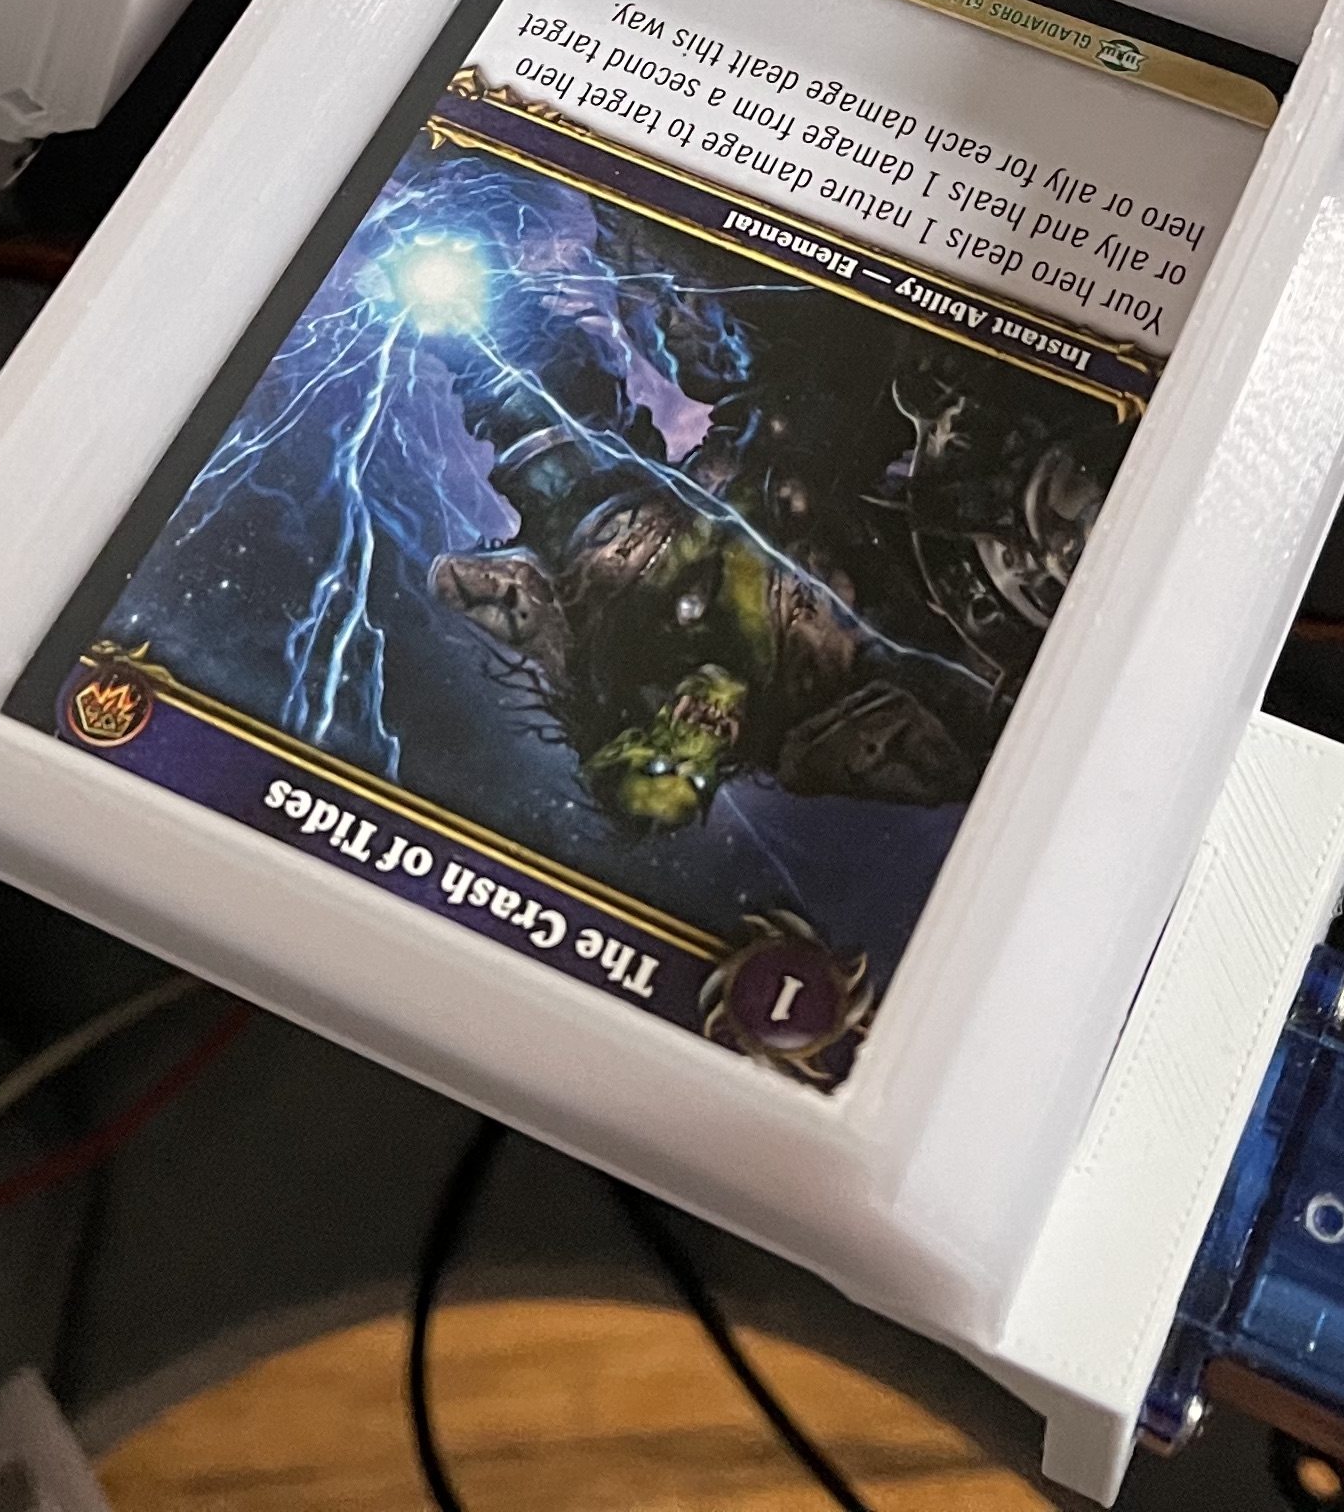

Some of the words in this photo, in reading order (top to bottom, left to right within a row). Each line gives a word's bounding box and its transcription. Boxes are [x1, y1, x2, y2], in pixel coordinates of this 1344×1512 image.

[517, 12, 601, 64] target
[611, 2, 665, 40] way.
[989, 2, 1093, 50] GLADIATORS
[671, 28, 725, 67] this
[515, 57, 575, 100] hero
[602, 47, 701, 98] second
[727, 49, 800, 94] dealt
[577, 81, 662, 135] target
[707, 87, 727, 107] a
[732, 96, 796, 141] from
[806, 80, 917, 140] damage
[667, 118, 696, 148] to
[802, 124, 915, 186] damage
[924, 125, 992, 164] each
[701, 131, 813, 193] damage
[922, 170, 941, 198] 1
[995, 154, 1038, 189] for
[819, 178, 913, 229] nature
[947, 181, 1027, 232] heals
[1042, 167, 1098, 204] ally
[1100, 193, 1134, 218] or
[722, 210, 859, 279] Elemental
[918, 217, 938, 245] 1
[945, 227, 1024, 276] deals
[1029, 213, 1090, 248] and
[1141, 206, 1206, 252] hero
[1093, 233, 1150, 272] ally
[1153, 260, 1187, 285] or
[894, 277, 989, 328] Ability
[1031, 261, 1096, 308] hero
[1099, 288, 1164, 337] Your
[991, 317, 1092, 371] Instant
[264, 780, 378, 863] Tides
[375, 836, 433, 876] of
[441, 862, 567, 948] Crash
[575, 928, 659, 998] The
[770, 975, 804, 1021] 1
